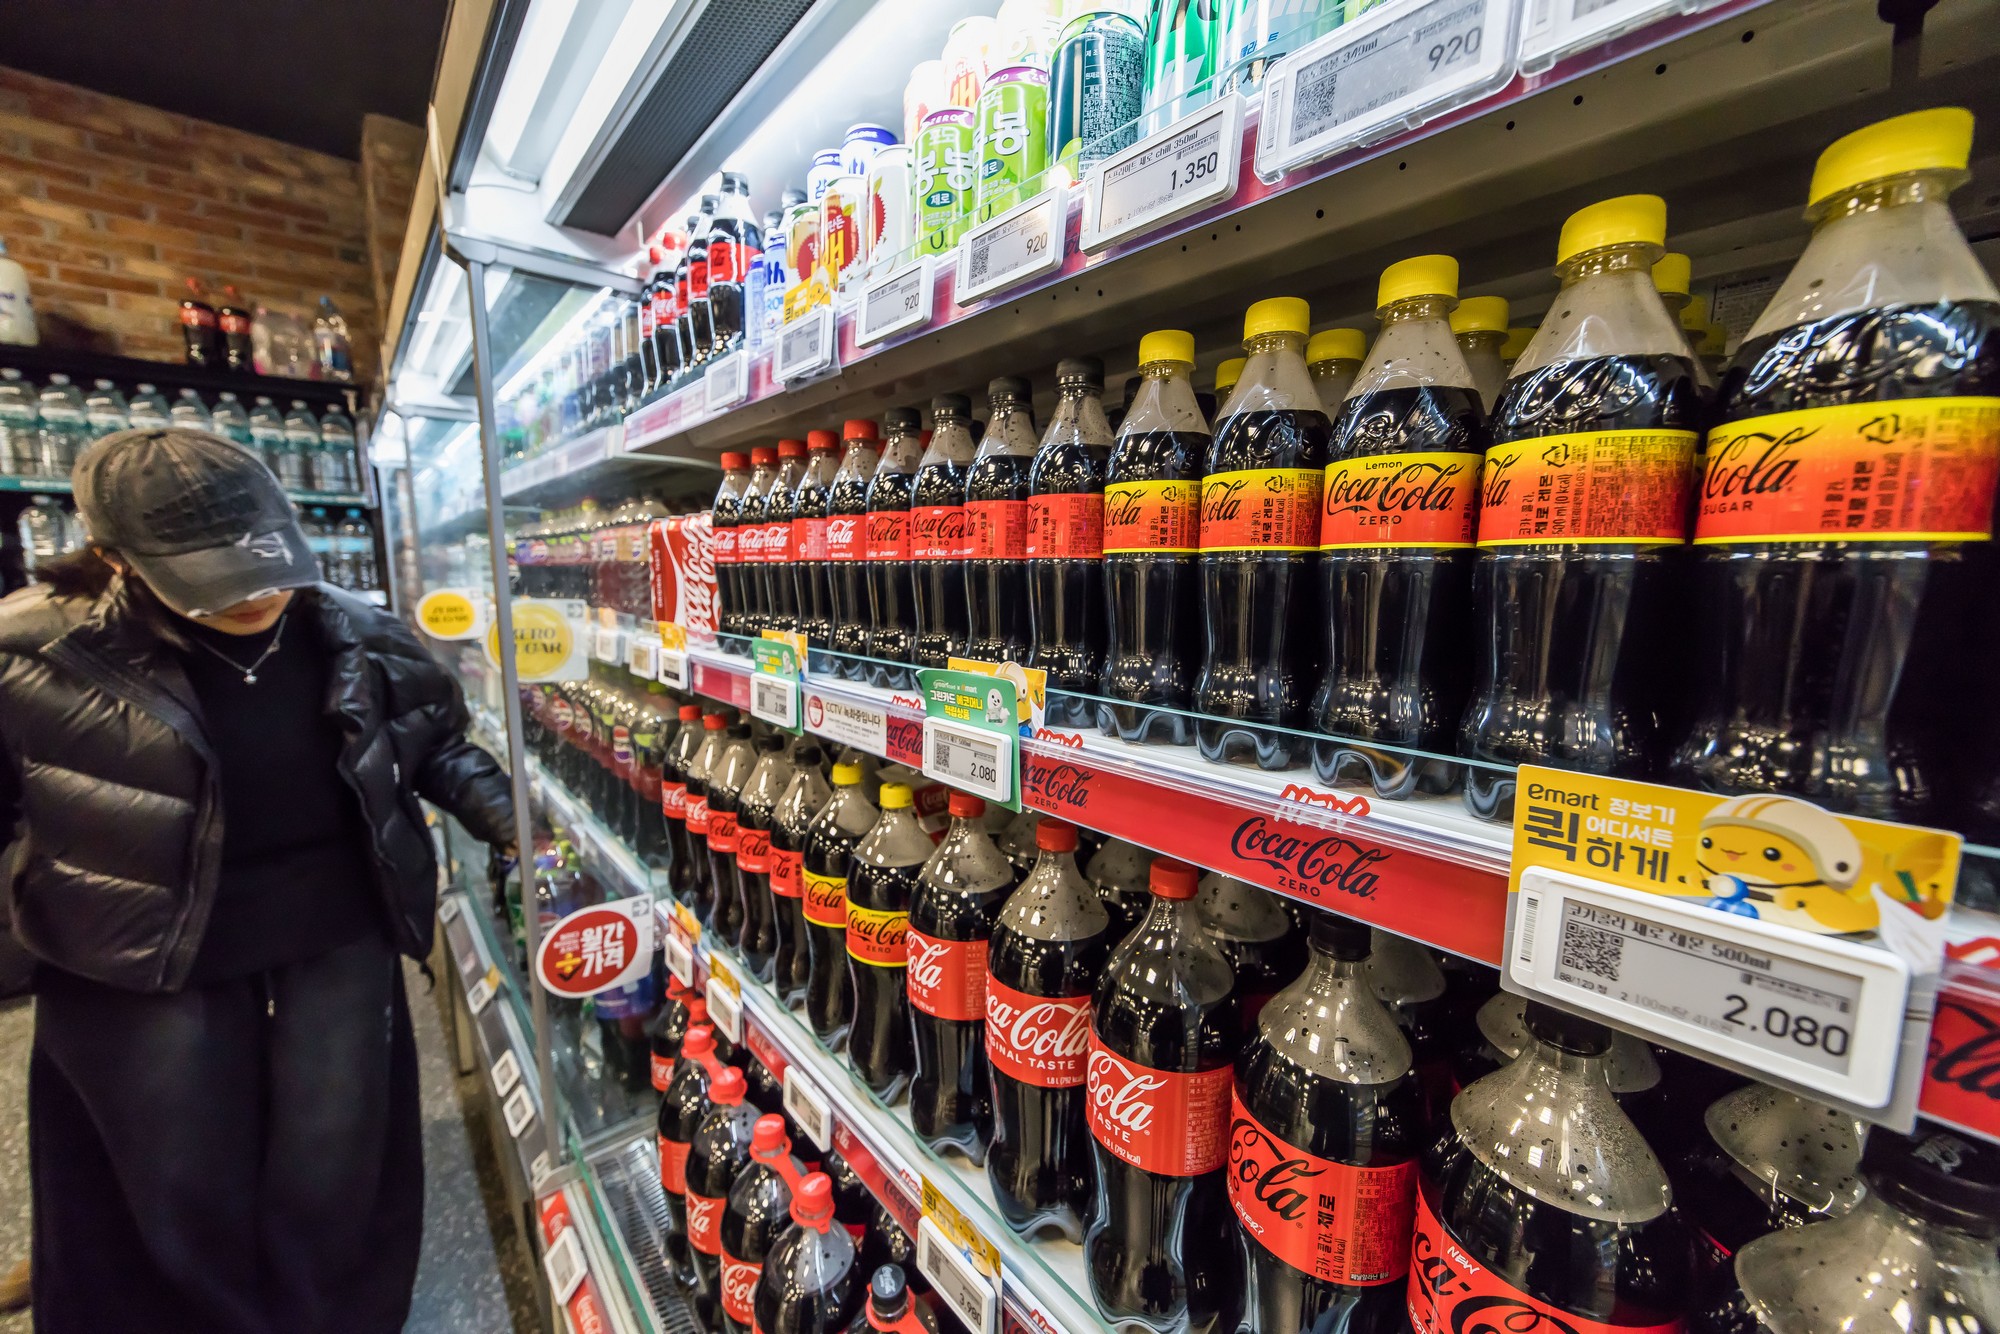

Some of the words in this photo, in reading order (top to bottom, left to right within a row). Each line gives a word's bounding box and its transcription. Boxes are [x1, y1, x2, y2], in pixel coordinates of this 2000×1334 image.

[1428, 27, 1482, 73] 920
[1155, 143, 1172, 159] chill
[1173, 129, 1198, 149] 350ml
[930, 193, 951, 206] 제로
[1026, 231, 1048, 256] 920
[904, 292, 919, 312] 920
[1365, 461, 1402, 471] Lemon
[1327, 463, 1465, 516] Coca-Cola
[1538, 474, 1554, 503] 레몬
[1358, 515, 1402, 526] ZERO
[1534, 507, 1550, 535] 제로
[1702, 500, 1754, 516] SUGAR
[826, 701, 843, 715] CCTV
[844, 709, 881, 728] 녹화중입니다
[1034, 796, 1059, 810] ZERO
[1527, 783, 1600, 811] emart
[1609, 797, 1676, 826] 장보기
[1585, 815, 1675, 848] 어디서든
[1231, 817, 1393, 898] Coca-Cola
[1277, 875, 1321, 897] ZERO
[581, 920, 626, 953] 월간
[866, 944, 892, 954] ZERO
[1568, 905, 1626, 931] 코카콜라
[1631, 922, 1665, 940] 제로
[1669, 930, 1704, 951] 레몬
[1711, 944, 1772, 971] 500ml
[581, 945, 624, 978] 가격
[1028, 1057, 1076, 1070] TASTE
[1087, 1050, 1169, 1132] Cola
[1093, 1104, 1131, 1144] TASTE
[1235, 1200, 1265, 1236] EVER?
[1317, 1194, 1336, 1230] 제로
[1446, 1245, 1480, 1275] NEW
